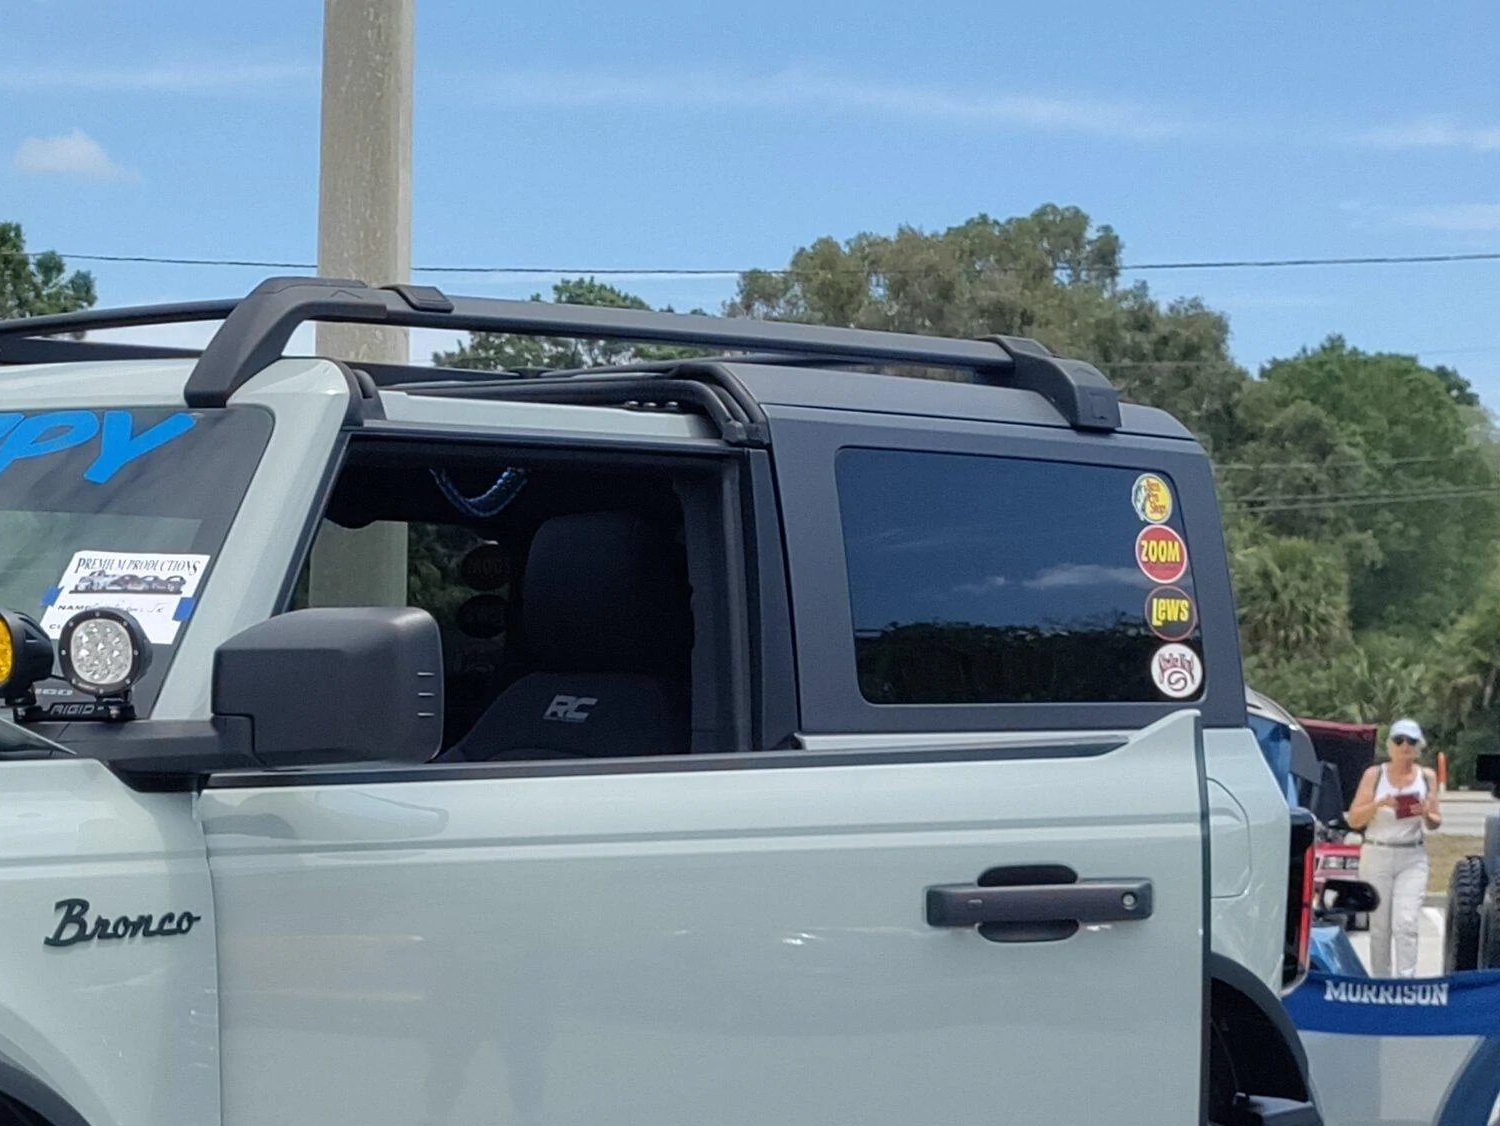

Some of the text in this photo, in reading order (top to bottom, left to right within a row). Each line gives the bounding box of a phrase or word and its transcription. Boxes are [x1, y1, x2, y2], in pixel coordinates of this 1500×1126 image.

[1140, 540, 1180, 562] ZOOM
[74, 557, 201, 576] PREMIUM PRODUCTIONS
[50, 704, 95, 716] RIGID
[543, 694, 598, 723] RC
[43, 898, 201, 947] Bronco
